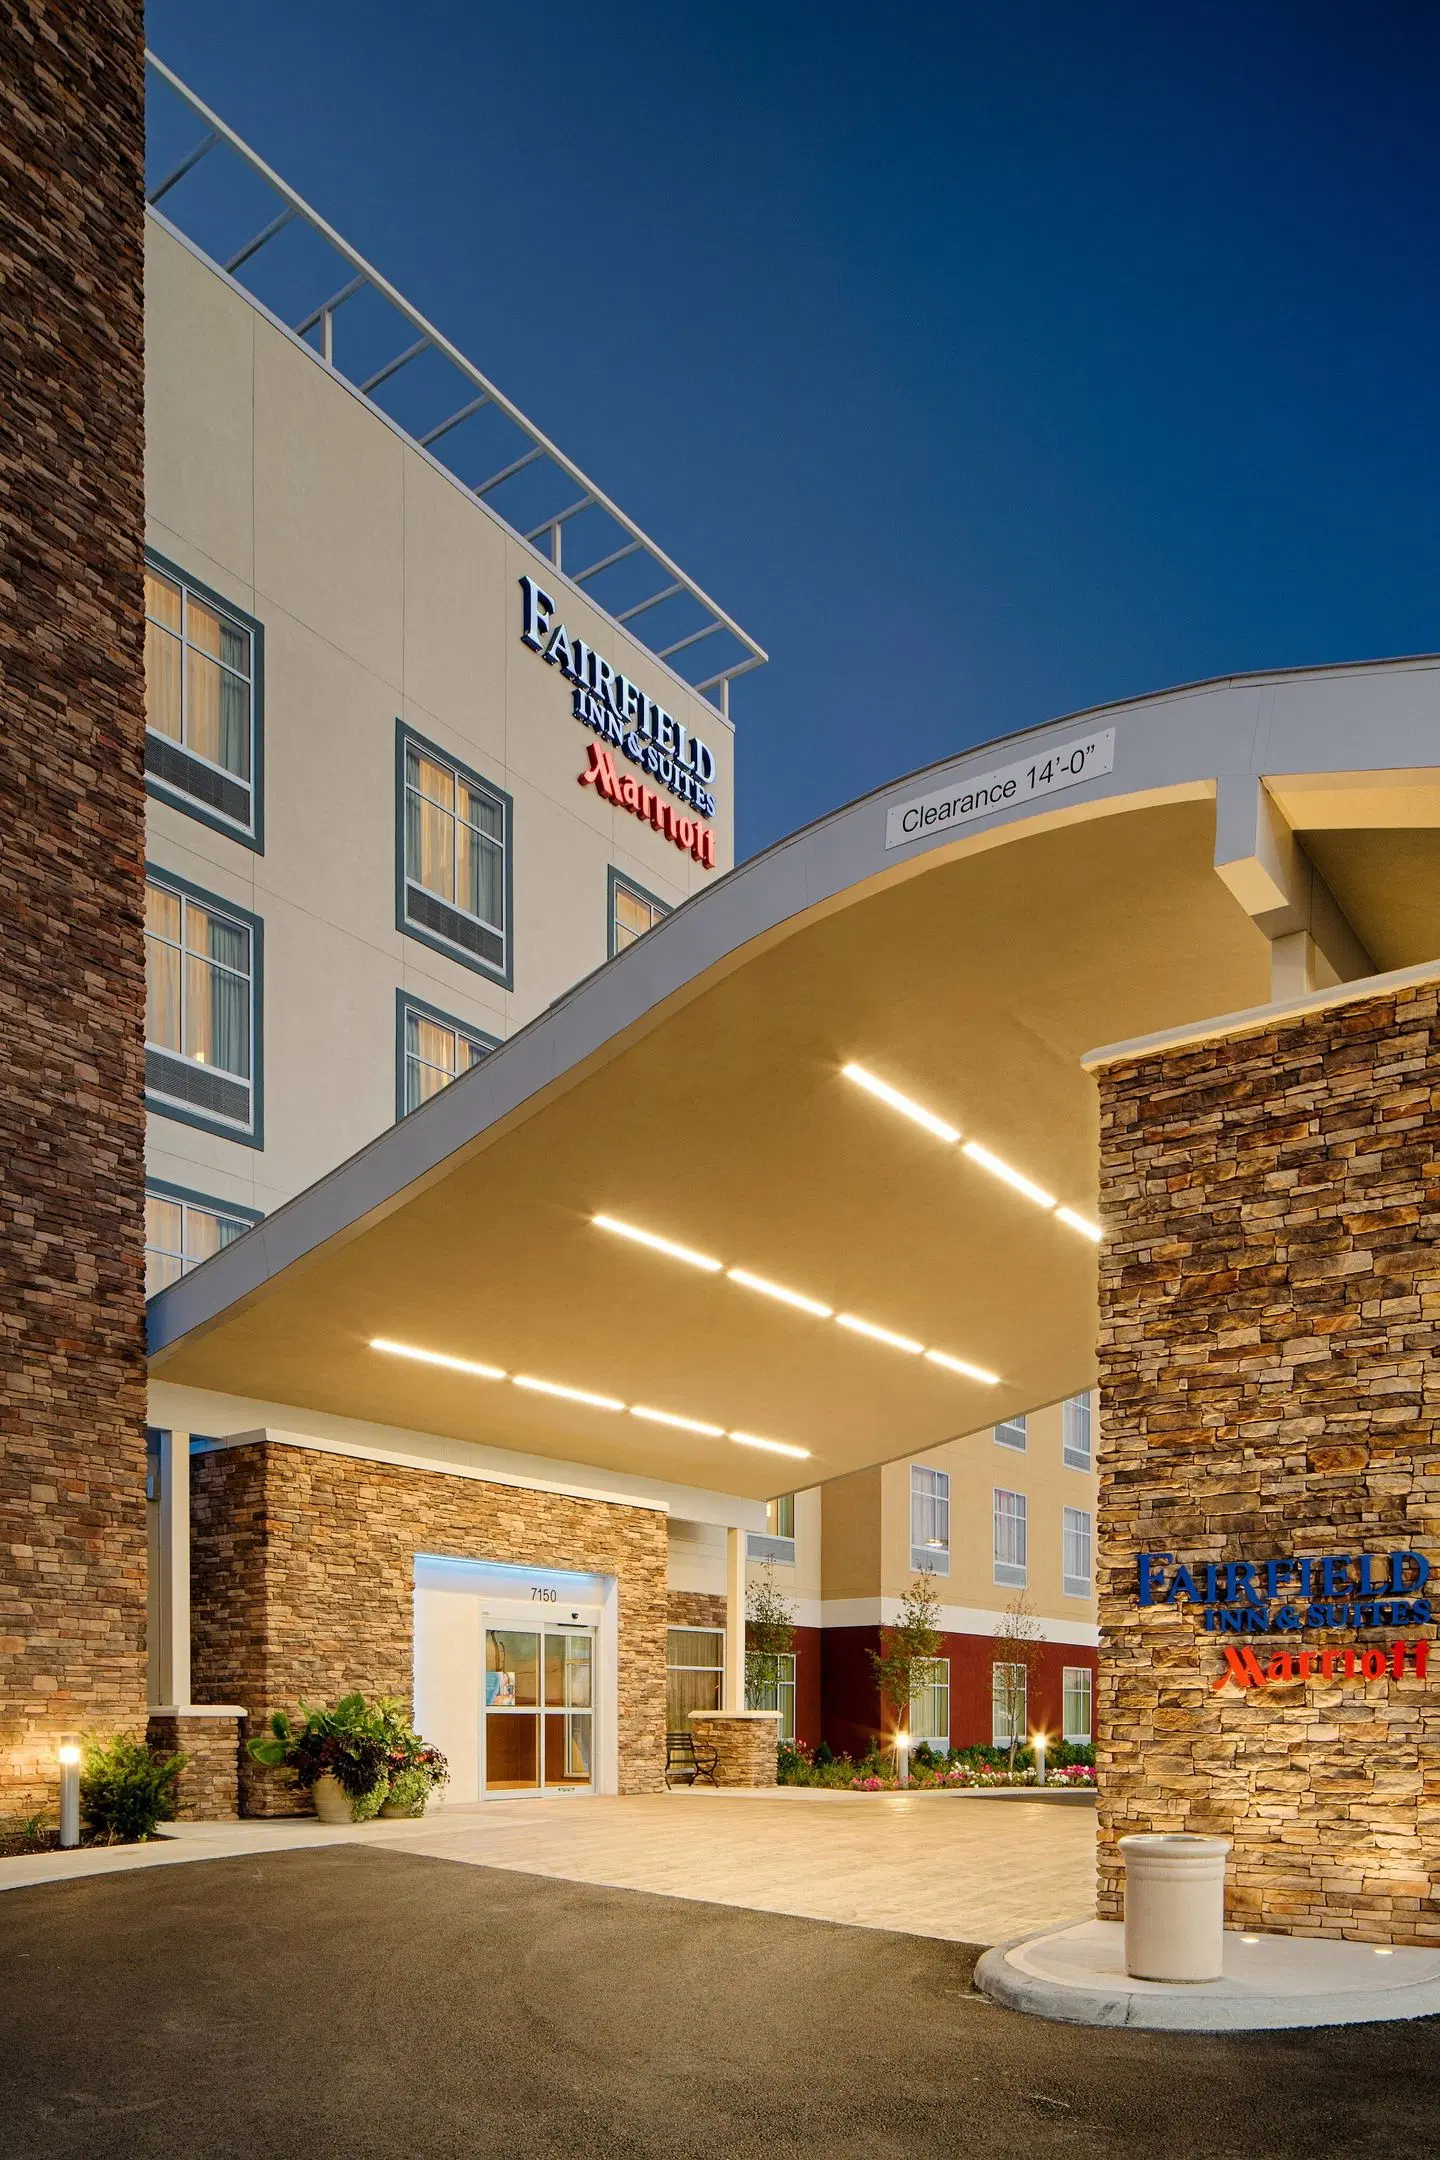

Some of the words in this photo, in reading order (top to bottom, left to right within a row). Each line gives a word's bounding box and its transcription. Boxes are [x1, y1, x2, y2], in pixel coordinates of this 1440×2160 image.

[519, 576, 716, 785] FAIRFIELD
[572, 688, 625, 748] INN
[620, 731, 645, 765] &
[642, 746, 716, 819] SUITES
[578, 742, 716, 870] Marriott
[902, 779, 1017, 832] Clearance
[531, 1587, 557, 1603] 7150
[1136, 1551, 1431, 1606] FAIRFIELD
[1204, 1606, 1269, 1632] INN
[1276, 1605, 1301, 1629] &
[1307, 1599, 1432, 1627] SUITES
[1212, 1639, 1428, 1691] Marriott
